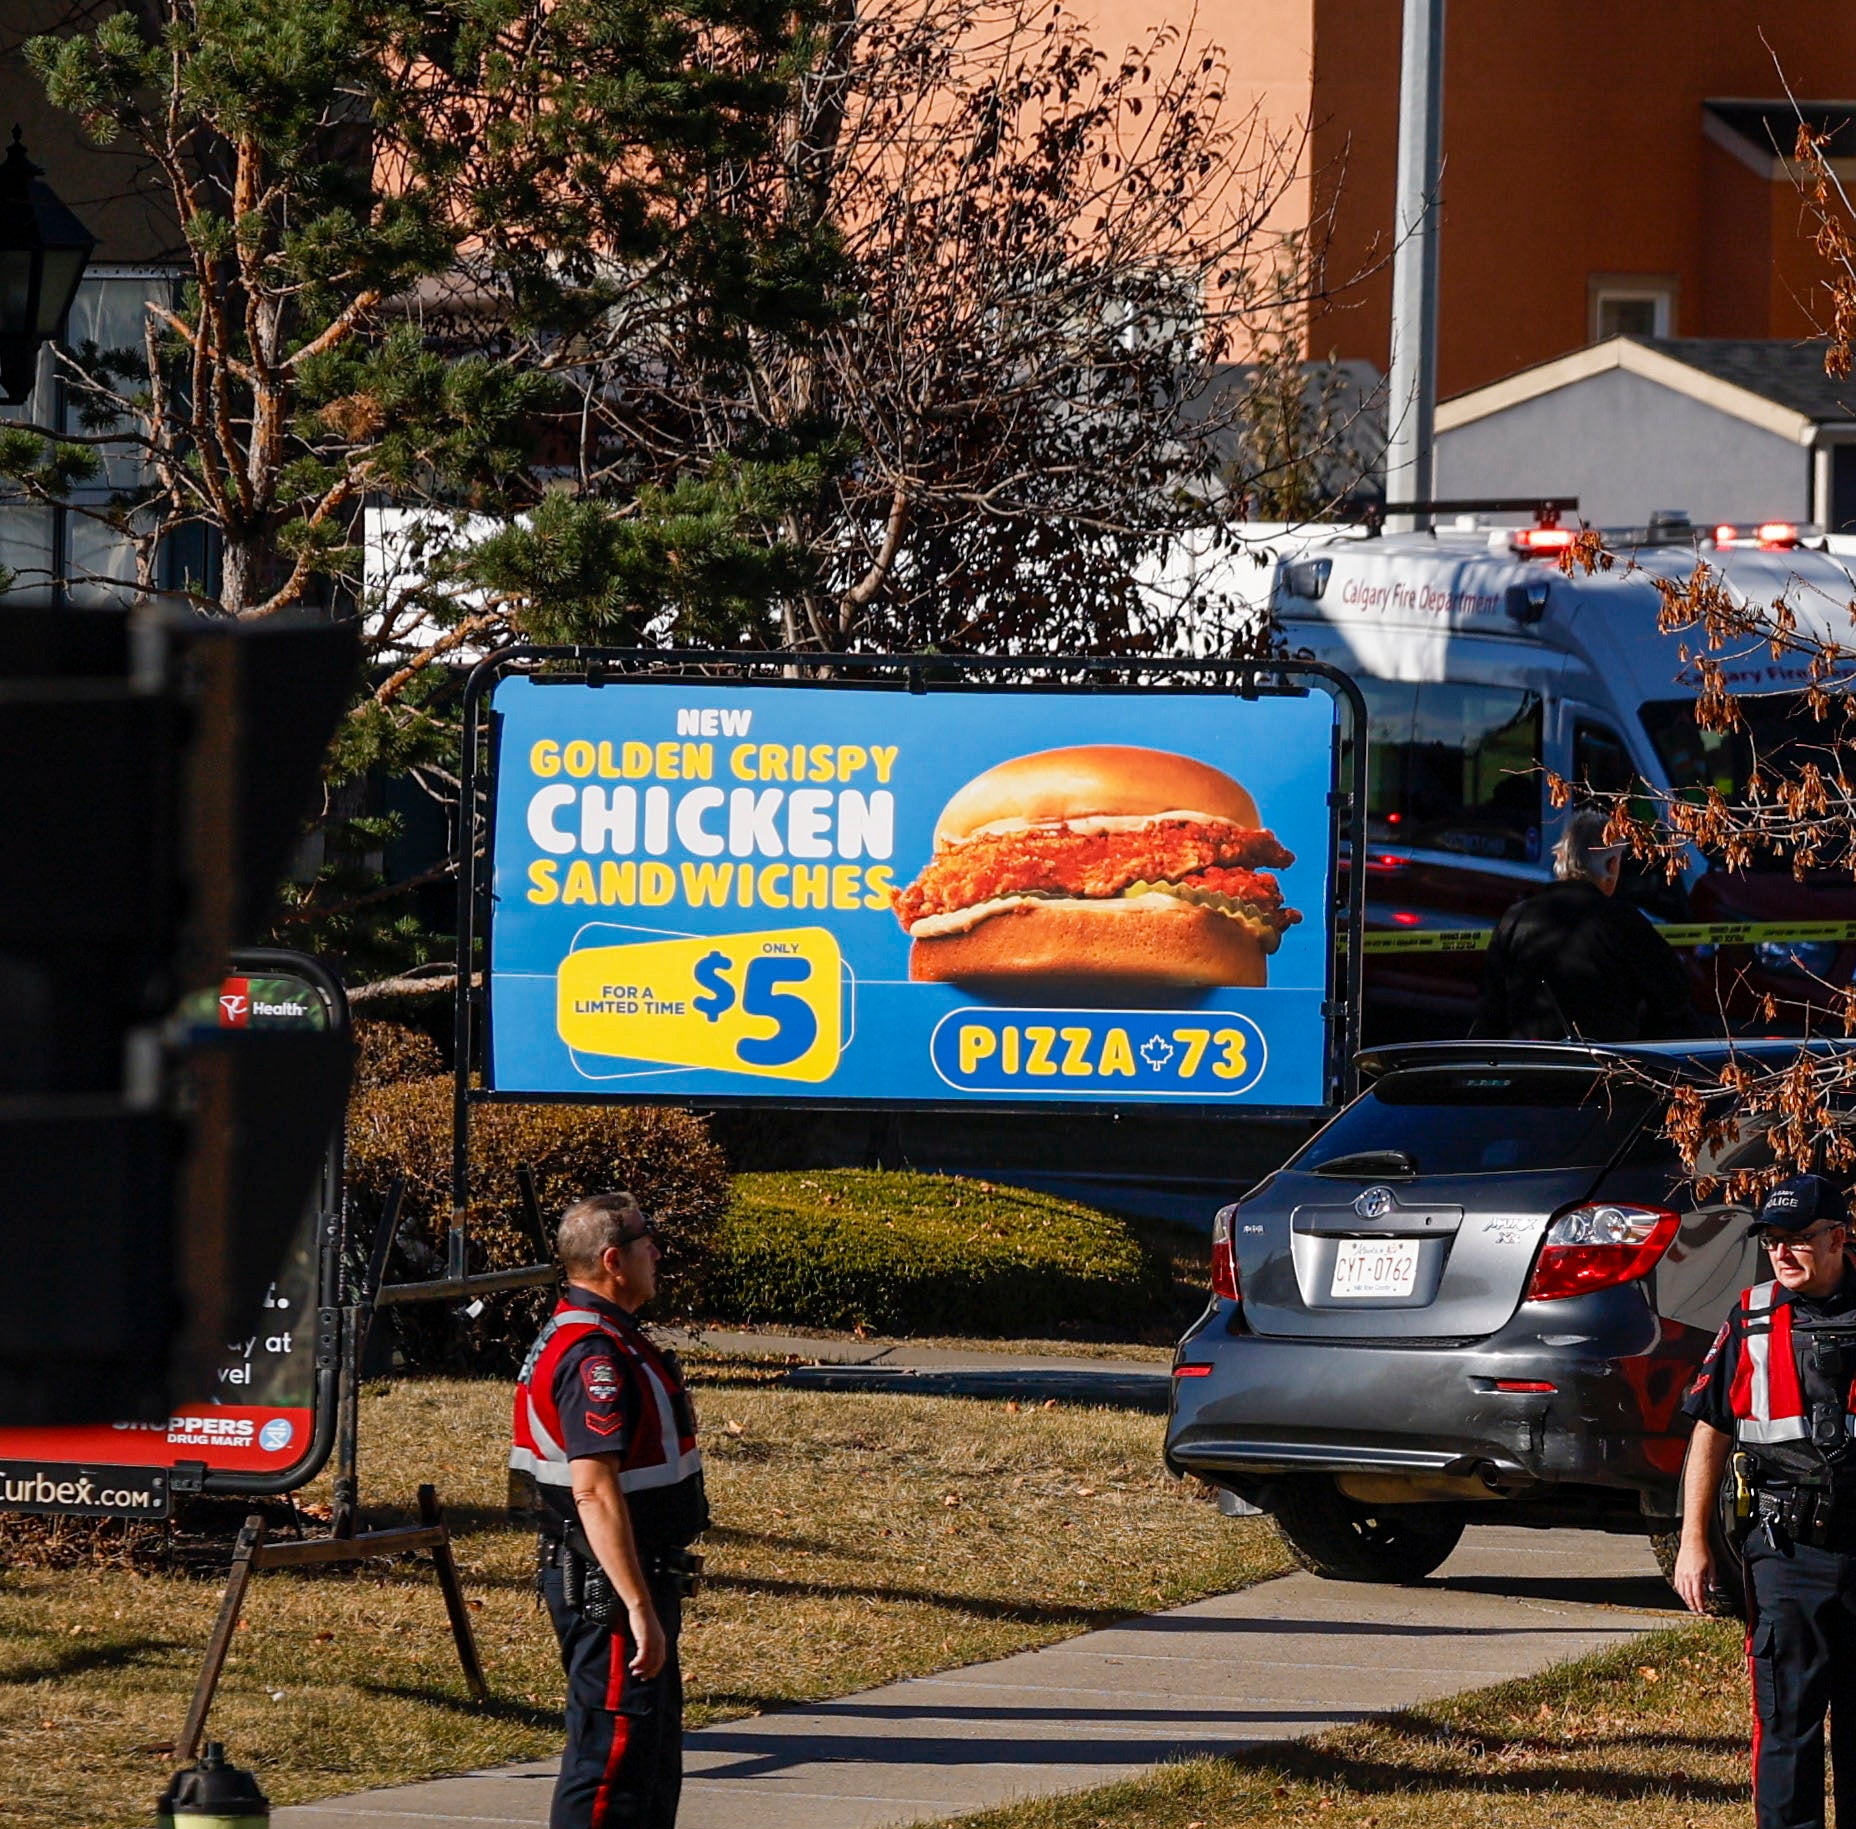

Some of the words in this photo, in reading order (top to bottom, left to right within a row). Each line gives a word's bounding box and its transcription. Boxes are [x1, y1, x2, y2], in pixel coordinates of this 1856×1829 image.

[1342, 579, 1391, 614] Calgary
[1392, 582, 1416, 609] Fire
[1419, 584, 1499, 617] Department
[676, 708, 752, 737] NEW
[529, 739, 713, 780] GOLDEN
[730, 743, 899, 783] CRISPY
[527, 783, 895, 860] CHICKEN
[526, 858, 895, 911] SANDWICHES
[762, 943, 799, 954] ONLY
[575, 1000, 639, 1014] LIMTED
[643, 1001, 686, 1015] TIME
[602, 985, 638, 999] FOR
[641, 986, 654, 999] A
[692, 950, 818, 1067] $5
[958, 1024, 1137, 1077] PIZZA
[1171, 1028, 1248, 1079] 73
[265, 1331, 293, 1353] at
[167, 1432, 208, 1445] DRUG
[211, 1435, 253, 1447] MART
